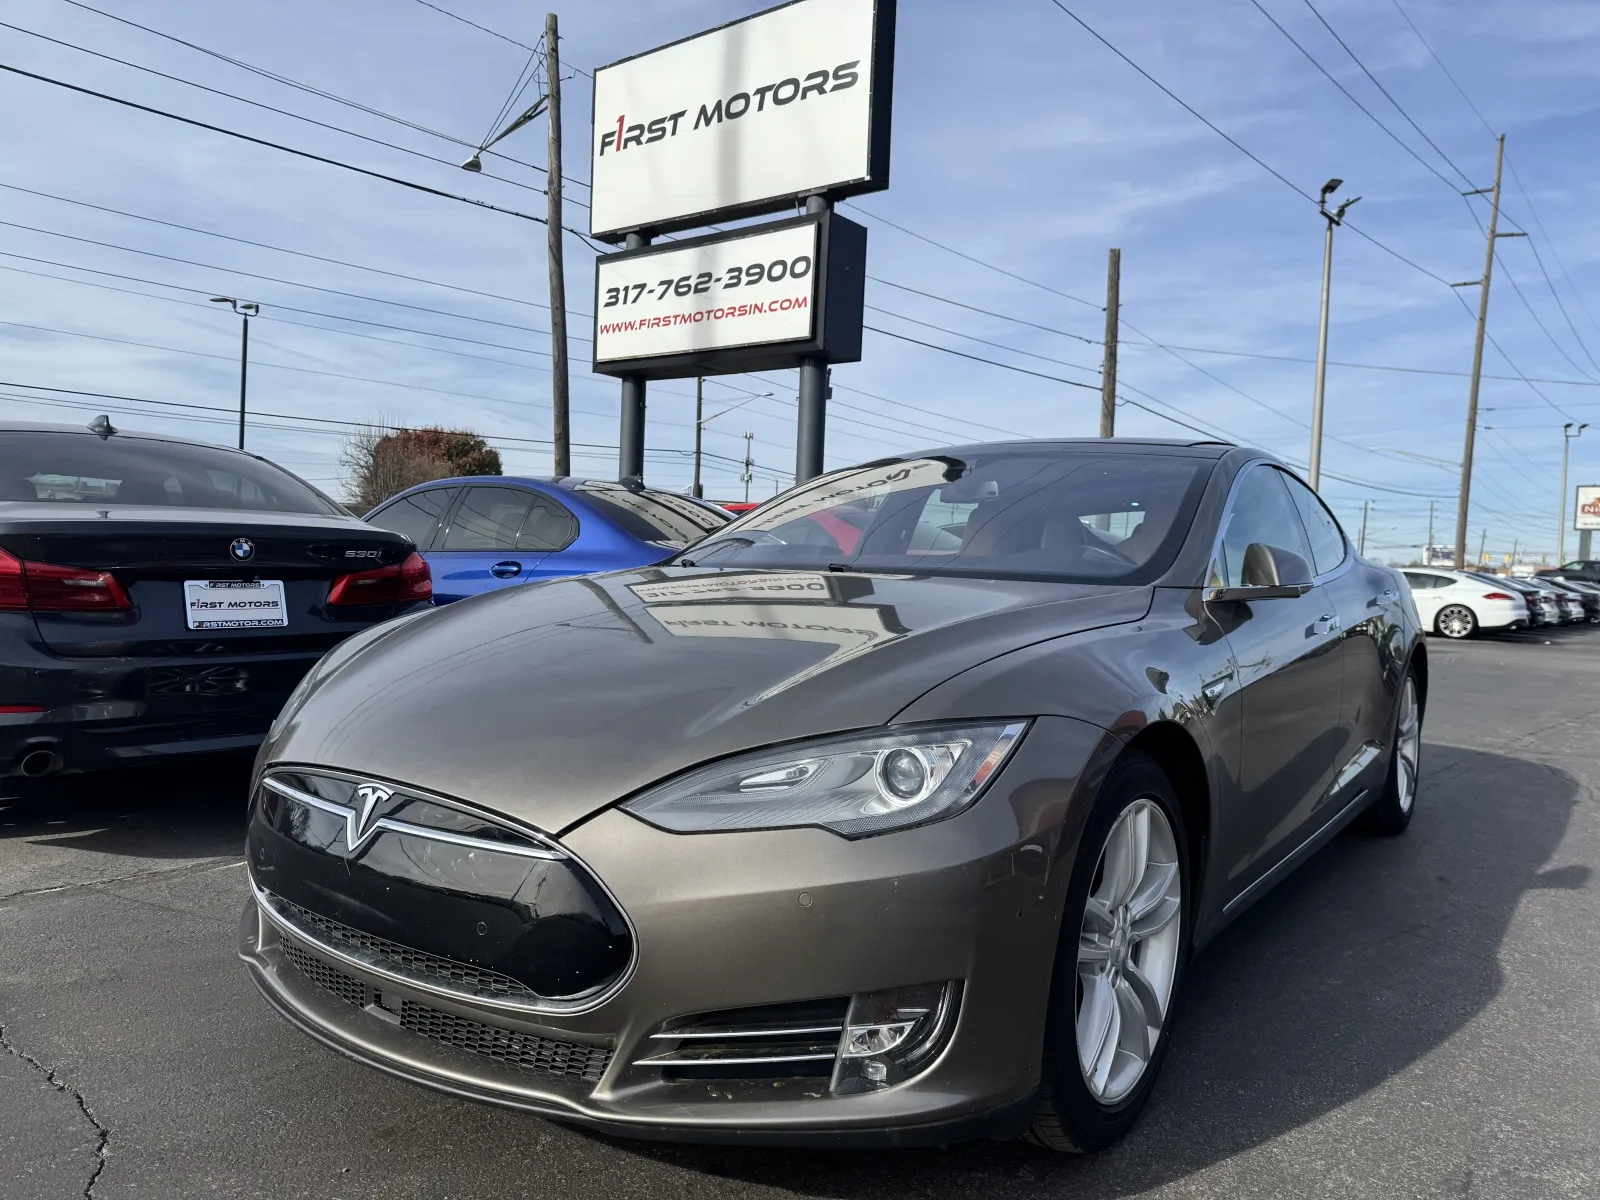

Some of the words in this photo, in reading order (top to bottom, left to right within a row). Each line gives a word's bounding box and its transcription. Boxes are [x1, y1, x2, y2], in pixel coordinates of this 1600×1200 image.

[693, 59, 861, 131] MOTORS
[603, 255, 812, 308] 317-762-3900
[600, 296, 808, 336] WWW.FIRSTMOTORSIN.COM
[227, 600, 279, 608] MOTORS
